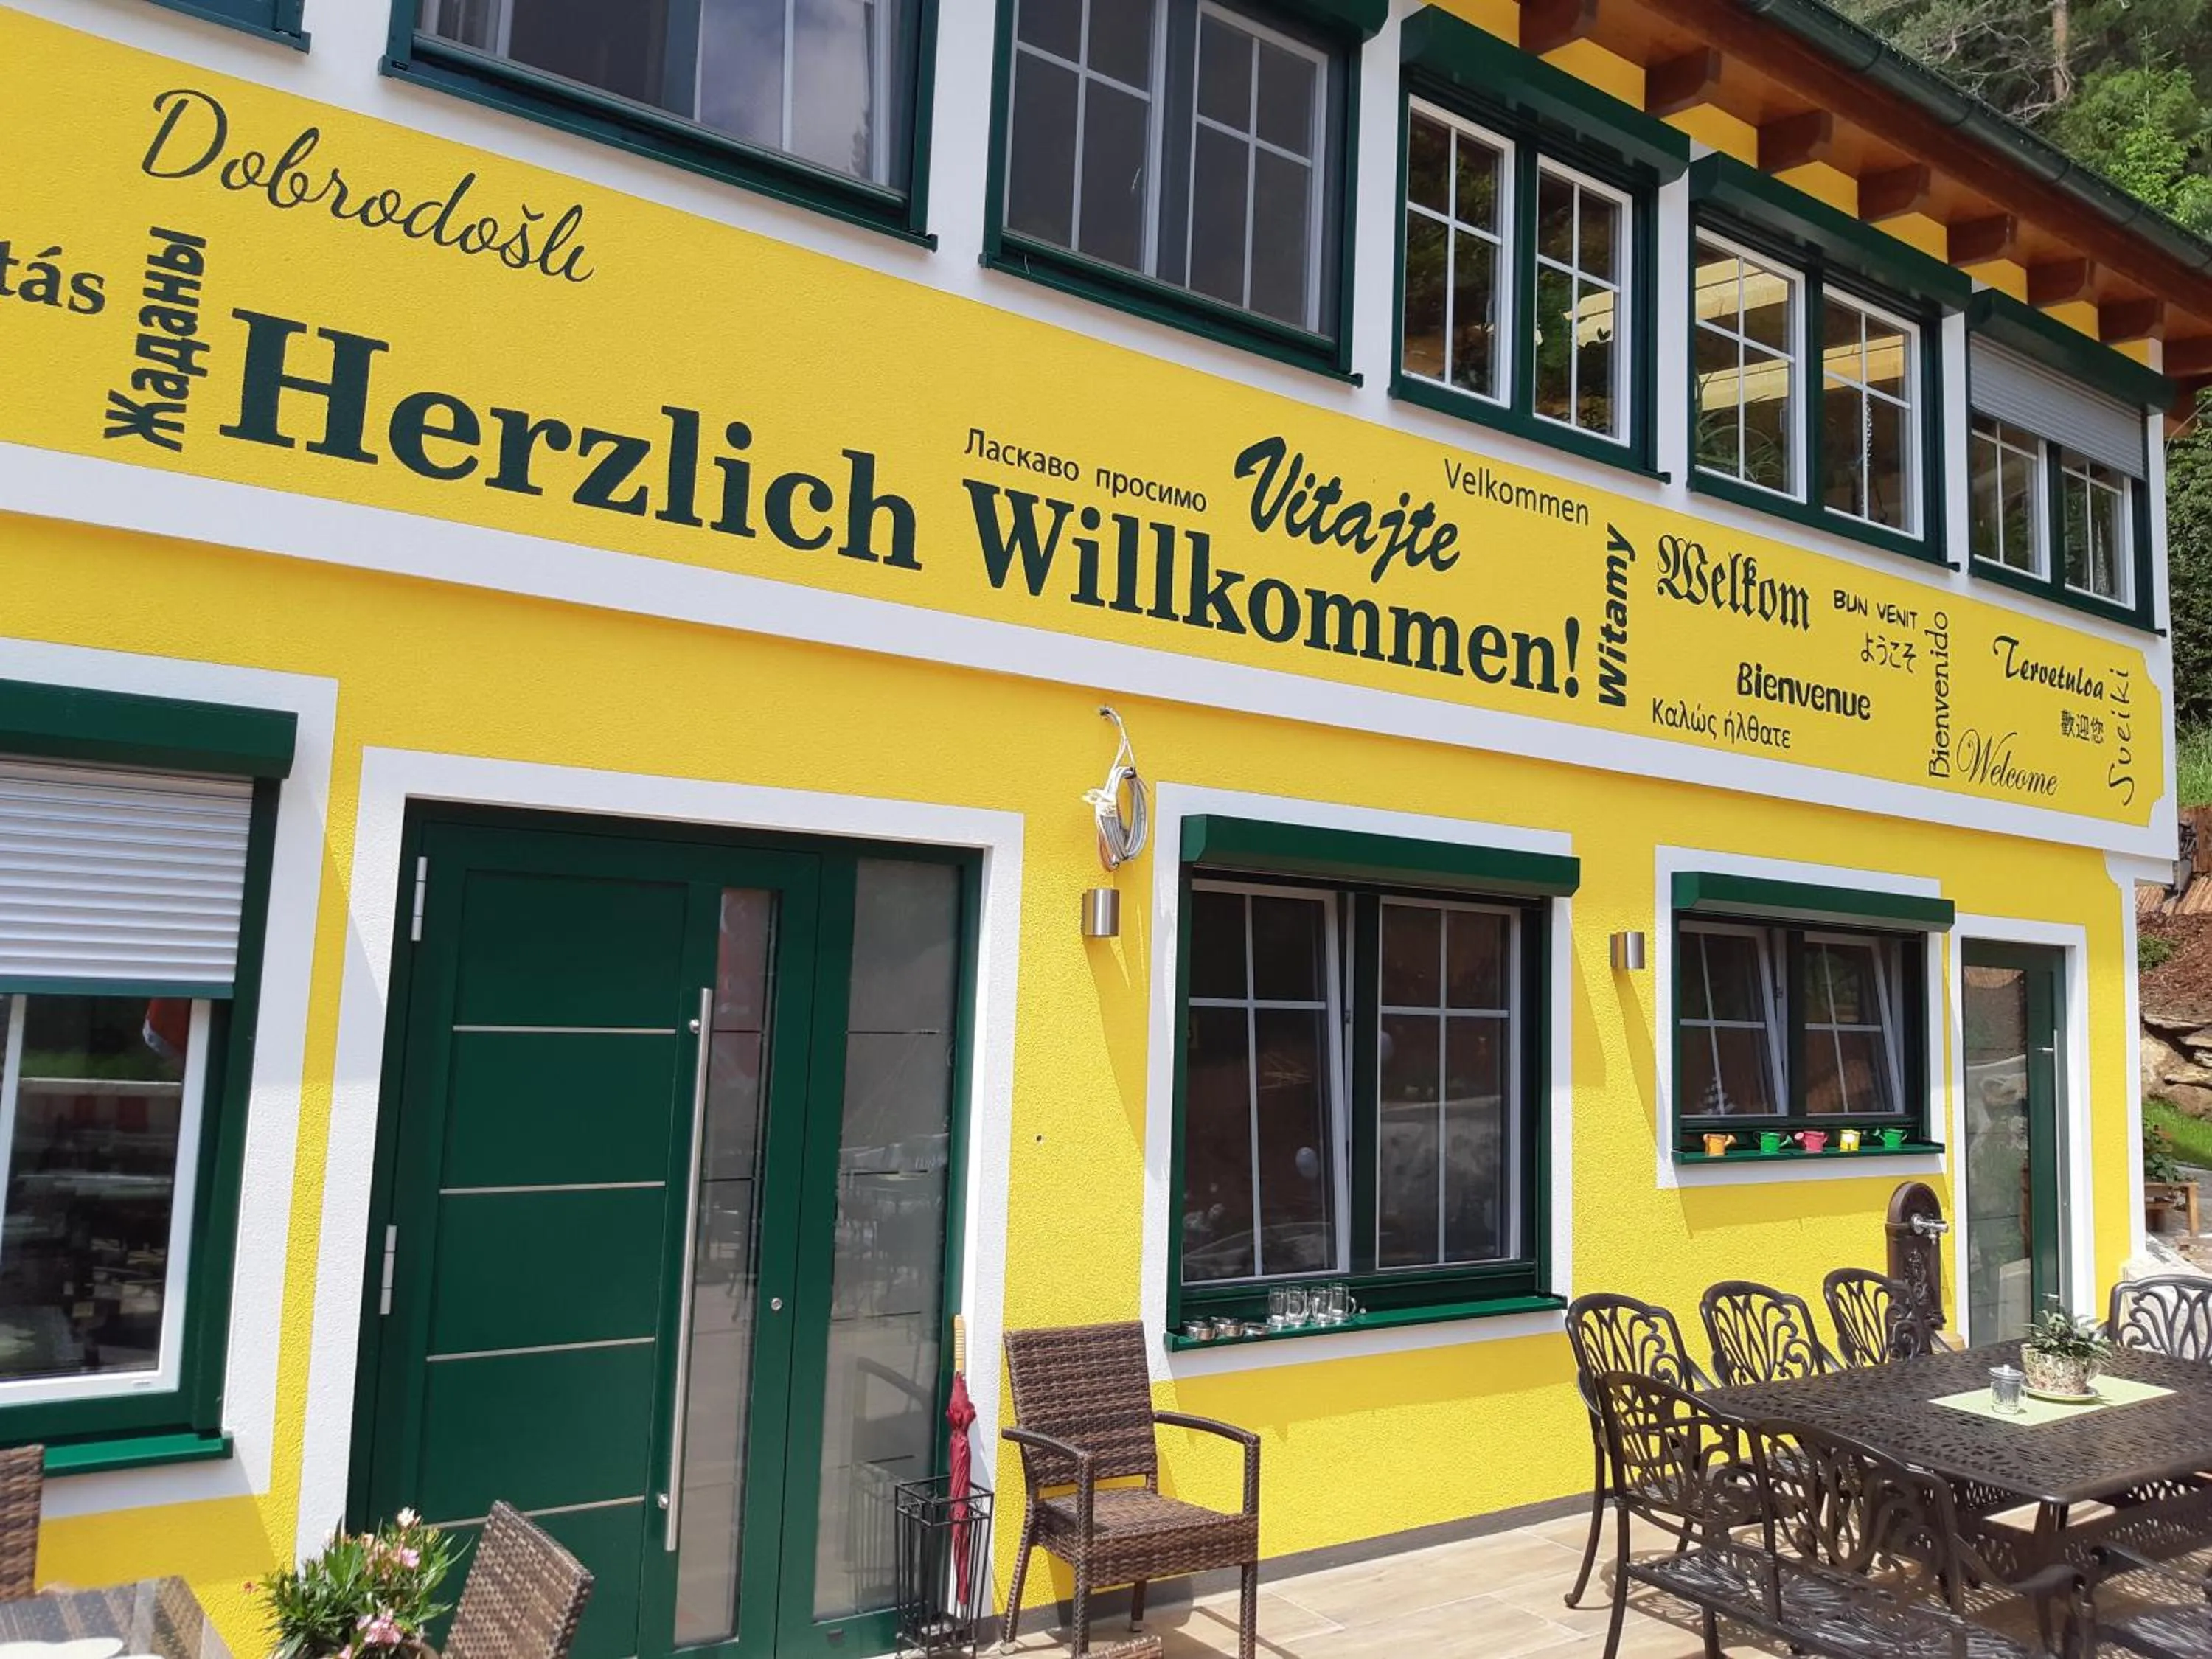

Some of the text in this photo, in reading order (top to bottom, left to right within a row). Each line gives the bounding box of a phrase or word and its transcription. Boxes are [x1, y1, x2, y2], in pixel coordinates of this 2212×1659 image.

[103, 226, 211, 452] Жаданы
[219, 307, 1581, 699] Herzlich Willkommen!
[964, 427, 1208, 513] Ласкаво просимо
[1234, 435, 1461, 584] Vitajte
[1444, 458, 1590, 526] Velkommen
[1597, 522, 1637, 708] Witamy
[1656, 535, 1810, 631] Welkom
[1833, 589, 1918, 630] BUN VENIT
[1736, 661, 1871, 721] Bienvenue
[1860, 631, 1917, 673] ようこそ
[1924, 611, 1951, 778] Bienvenido
[1992, 634, 2105, 700] Tervetuloa
[1652, 697, 1792, 749] Καλώς ήλθατε
[1956, 728, 2059, 796] Welcome
[2107, 667, 2135, 807] Sveiki
